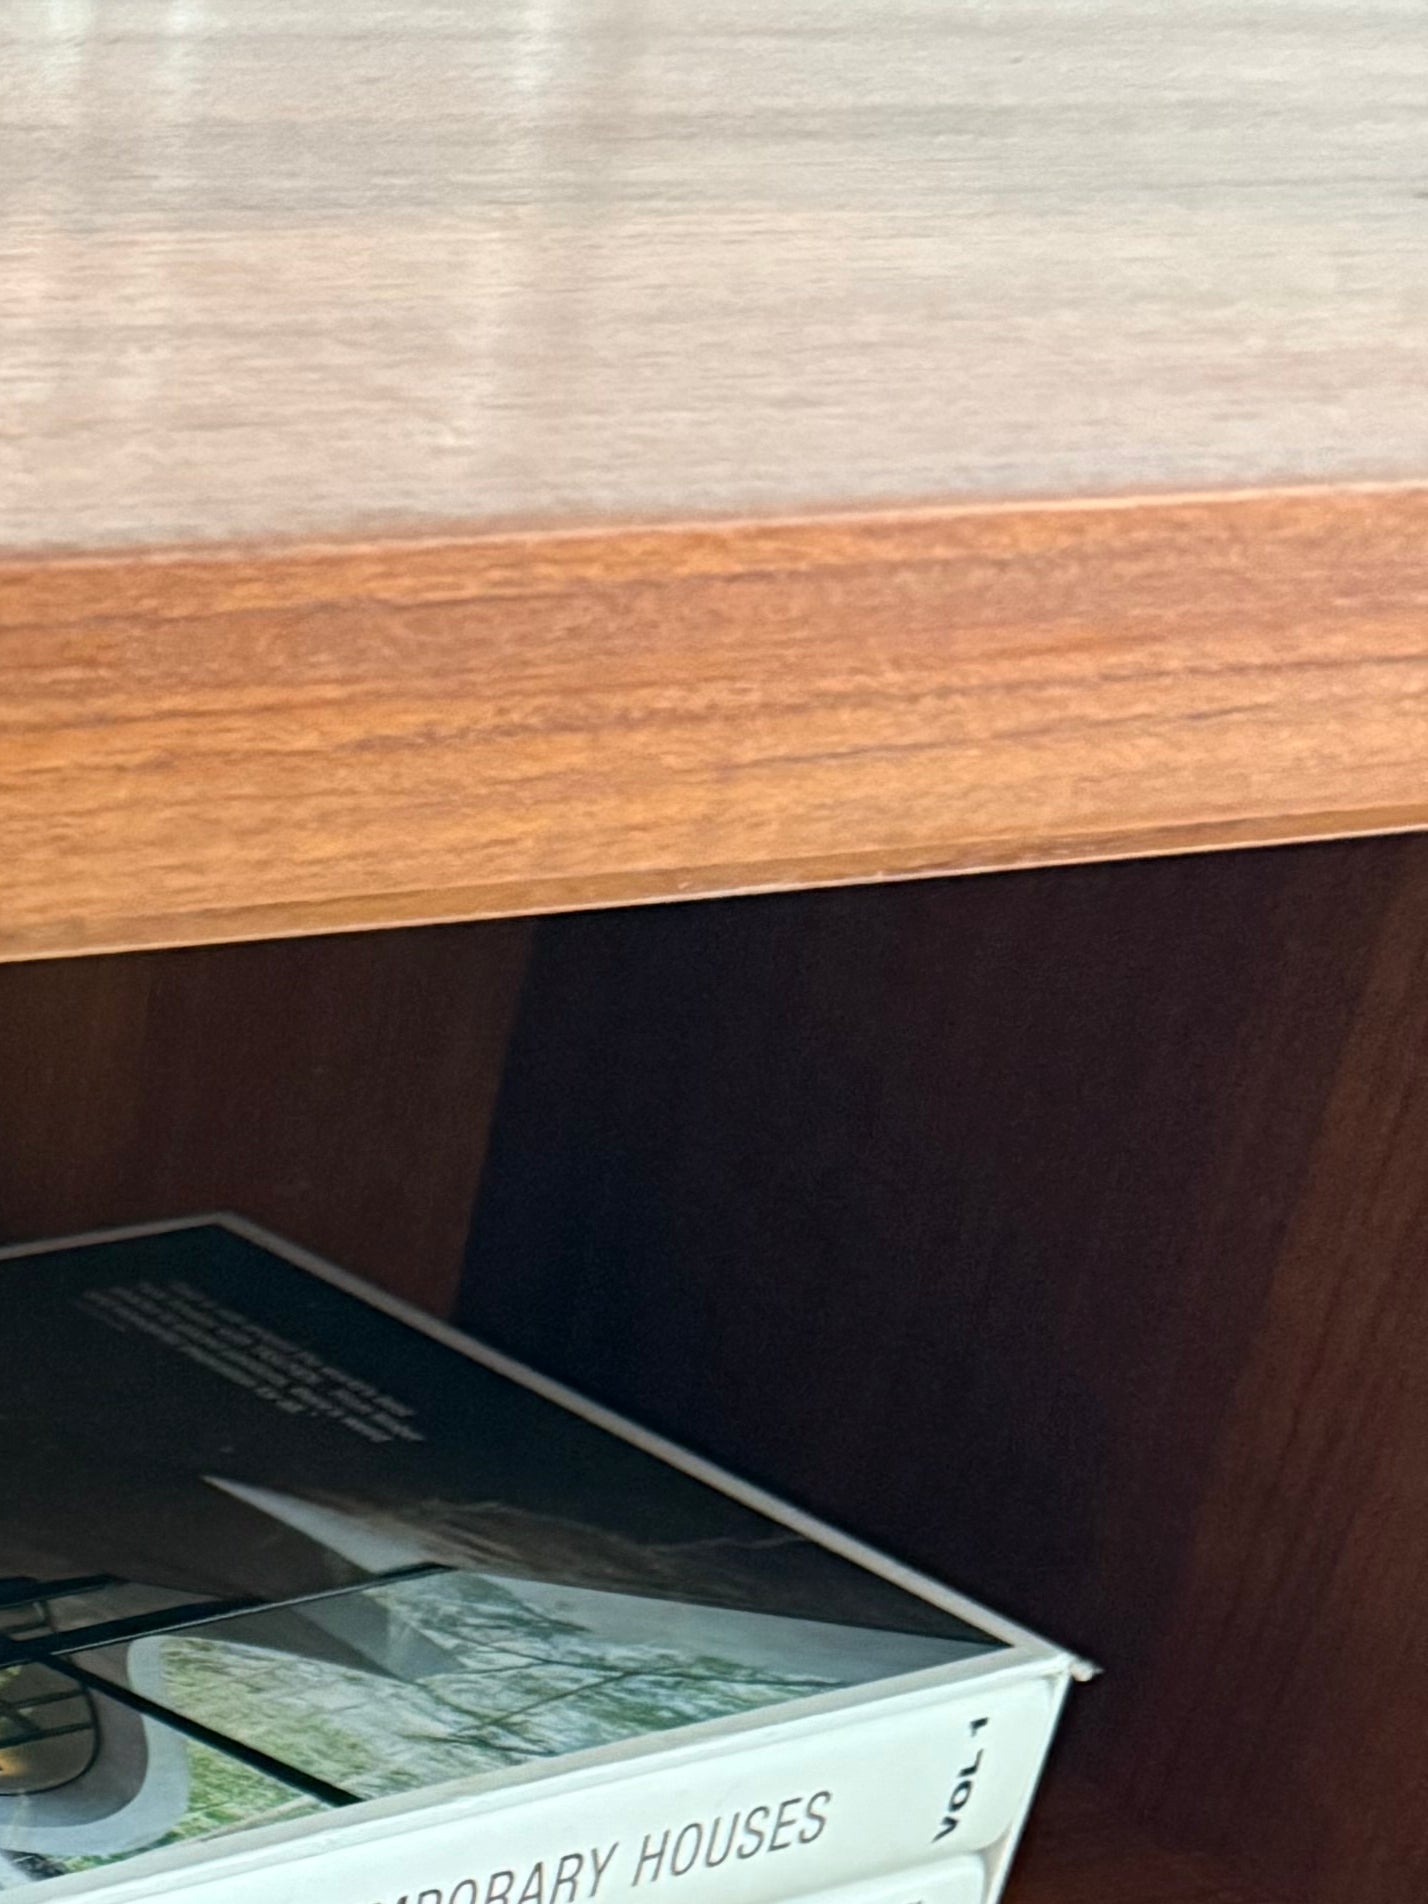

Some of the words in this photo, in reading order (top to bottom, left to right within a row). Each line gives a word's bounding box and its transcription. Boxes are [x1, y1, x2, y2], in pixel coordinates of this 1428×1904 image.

[933, 1748, 986, 1843] VOL
[970, 1716, 990, 1738] 1
[631, 1790, 833, 1888] HOUSES
